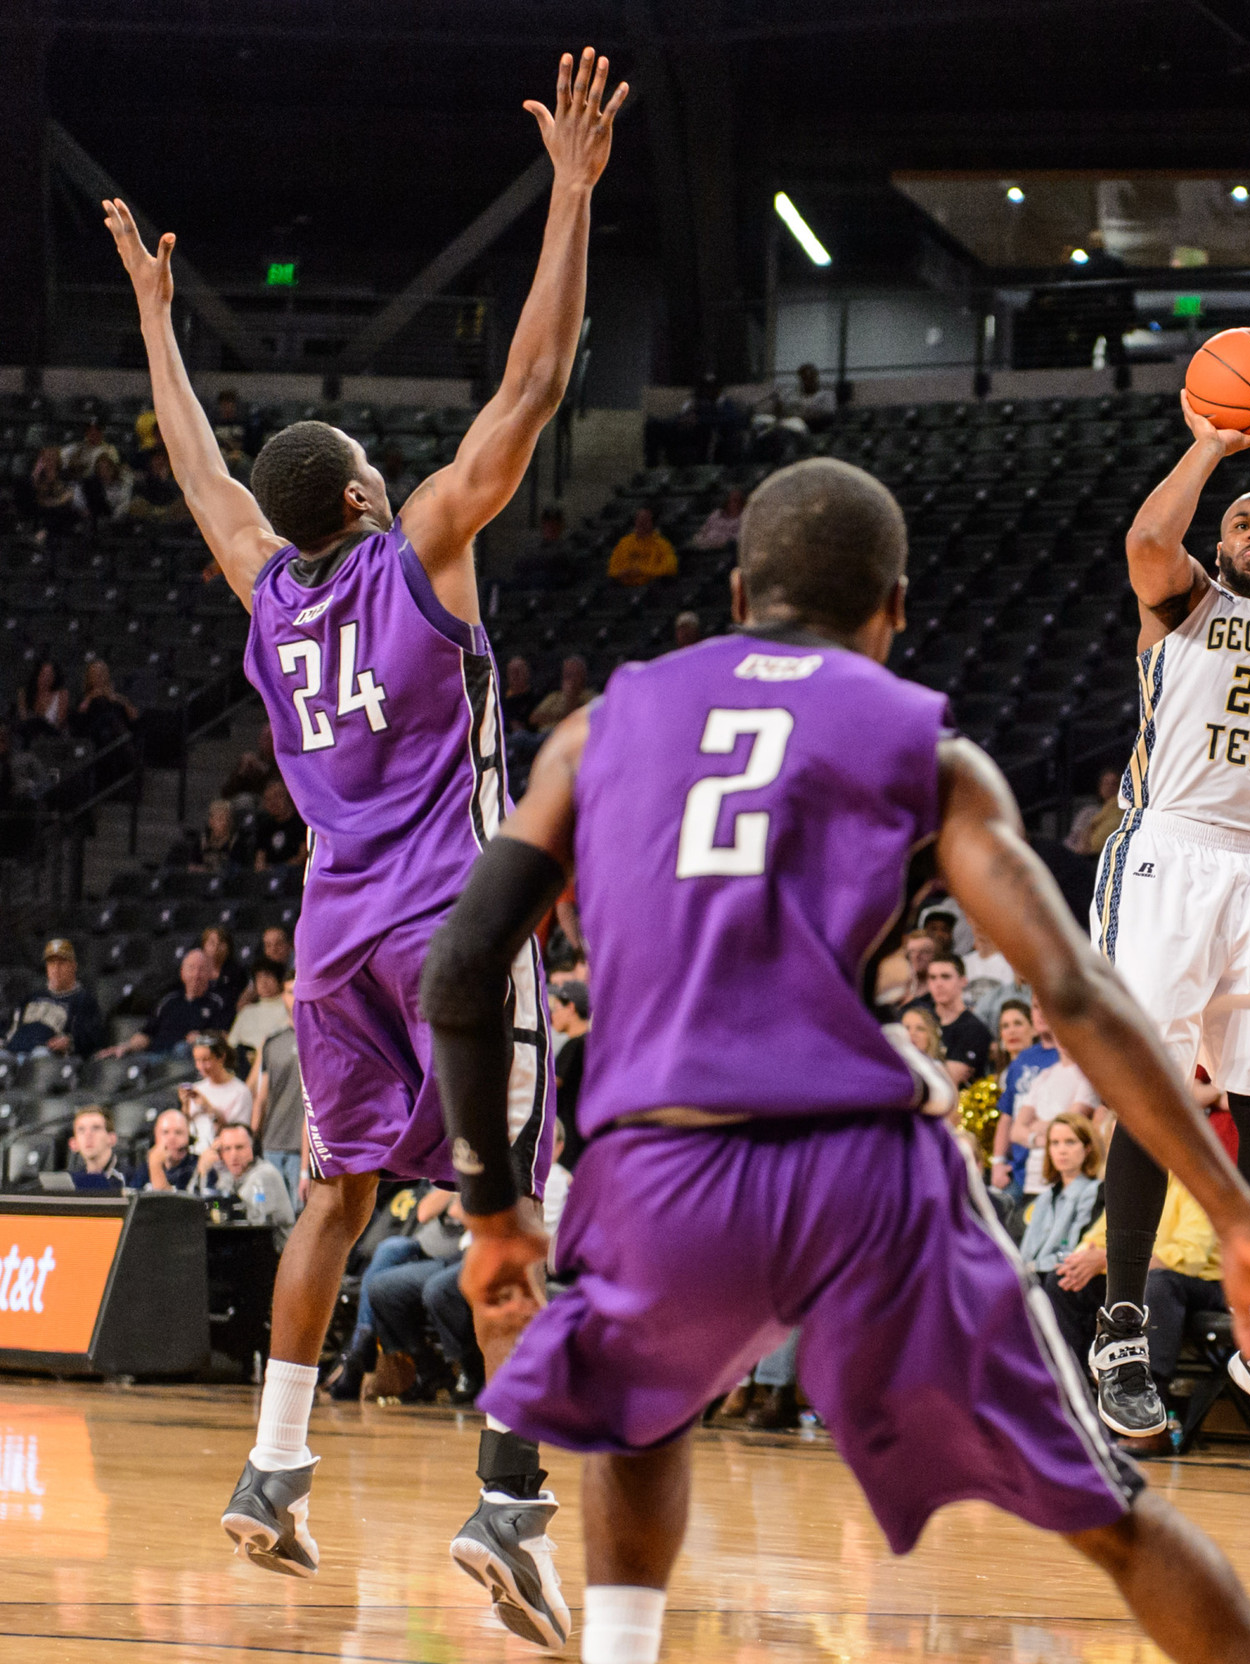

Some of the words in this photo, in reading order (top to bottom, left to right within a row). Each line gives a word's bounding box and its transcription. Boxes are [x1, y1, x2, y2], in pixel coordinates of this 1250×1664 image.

[276, 620, 389, 753] 24
[676, 707, 795, 880] 2
[310, 1124, 333, 1162] YOUNG
[0, 1244, 56, 1314] t&t
